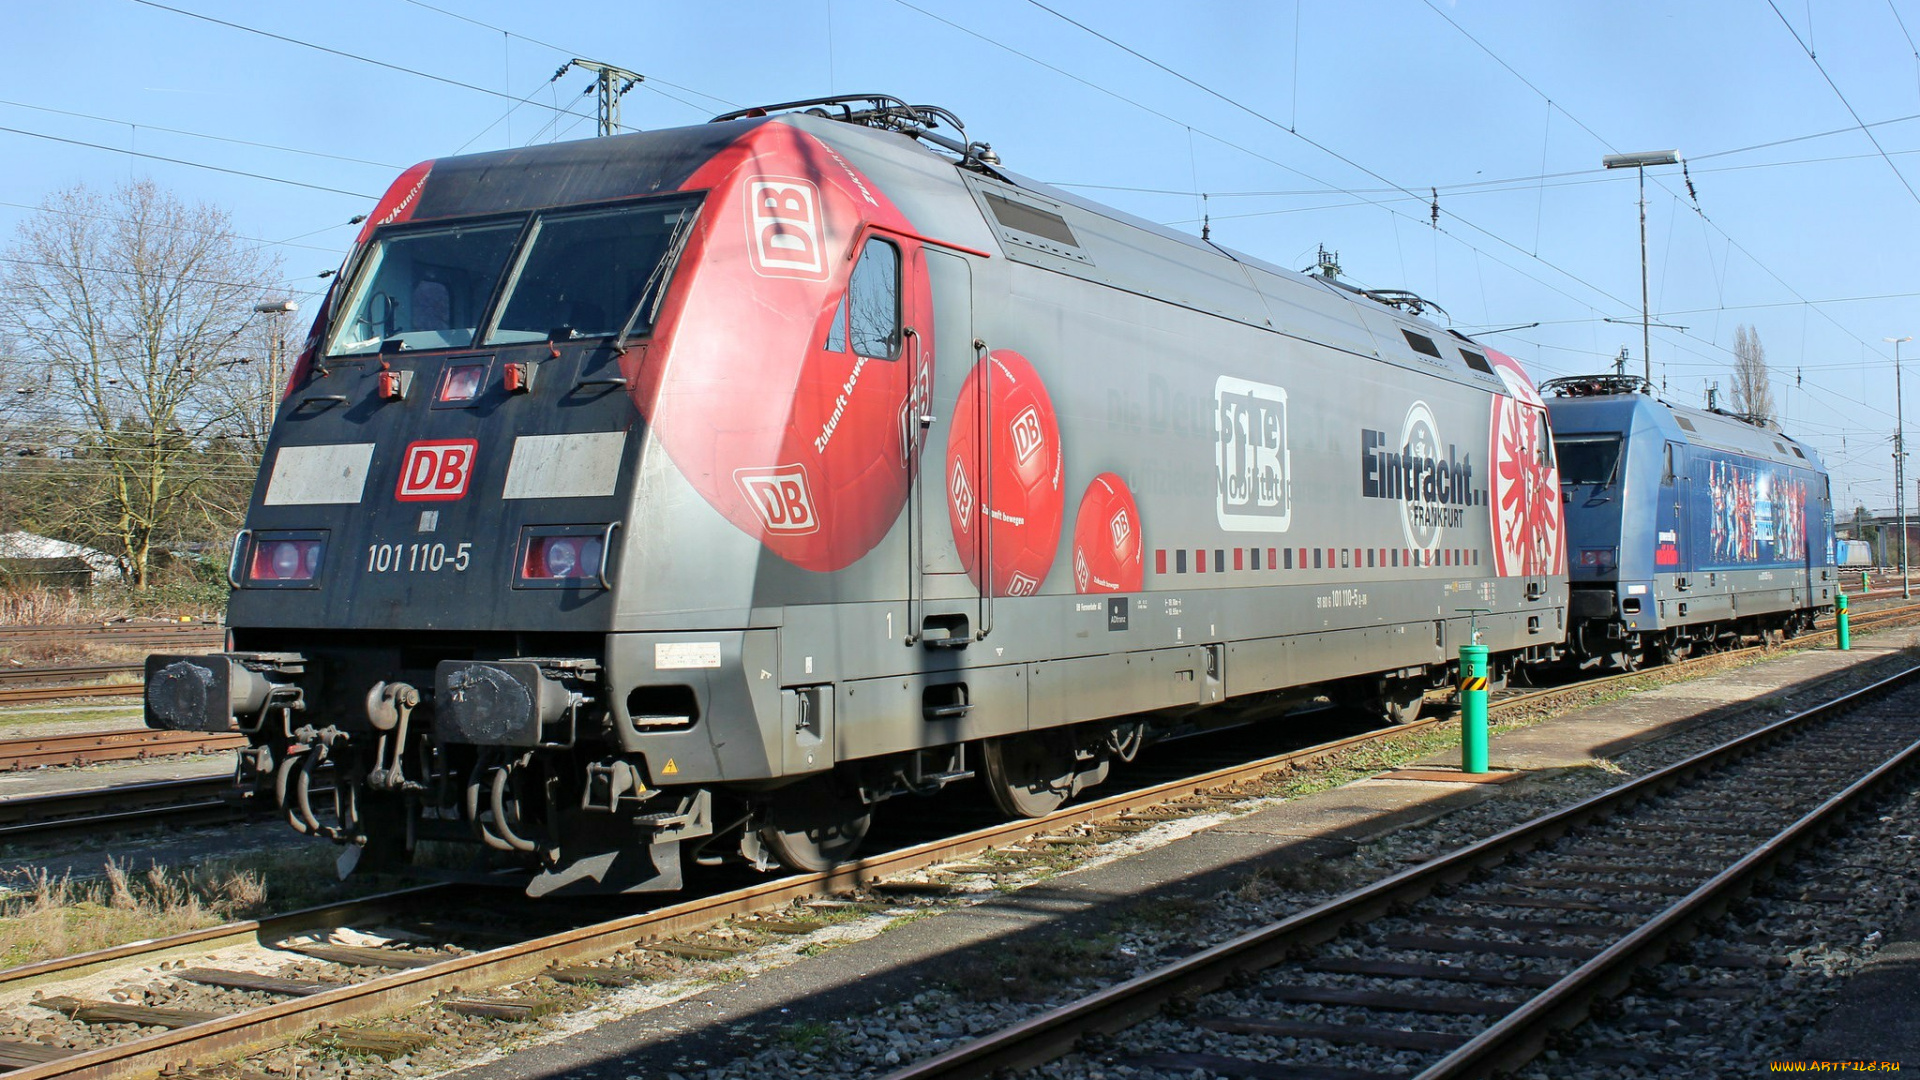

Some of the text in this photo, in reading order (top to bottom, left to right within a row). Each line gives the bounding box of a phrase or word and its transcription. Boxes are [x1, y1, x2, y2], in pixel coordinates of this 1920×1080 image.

[755, 185, 816, 266] DB
[813, 394, 848, 454] Zukunft
[1014, 412, 1040, 457] DB
[406, 448, 470, 492] DB
[749, 479, 809, 525] DB
[1413, 506, 1464, 528] FRANKFURT
[367, 542, 472, 573] 101 110-5
[1012, 576, 1034, 597] DB
[1467, 663, 1475, 678] 6
